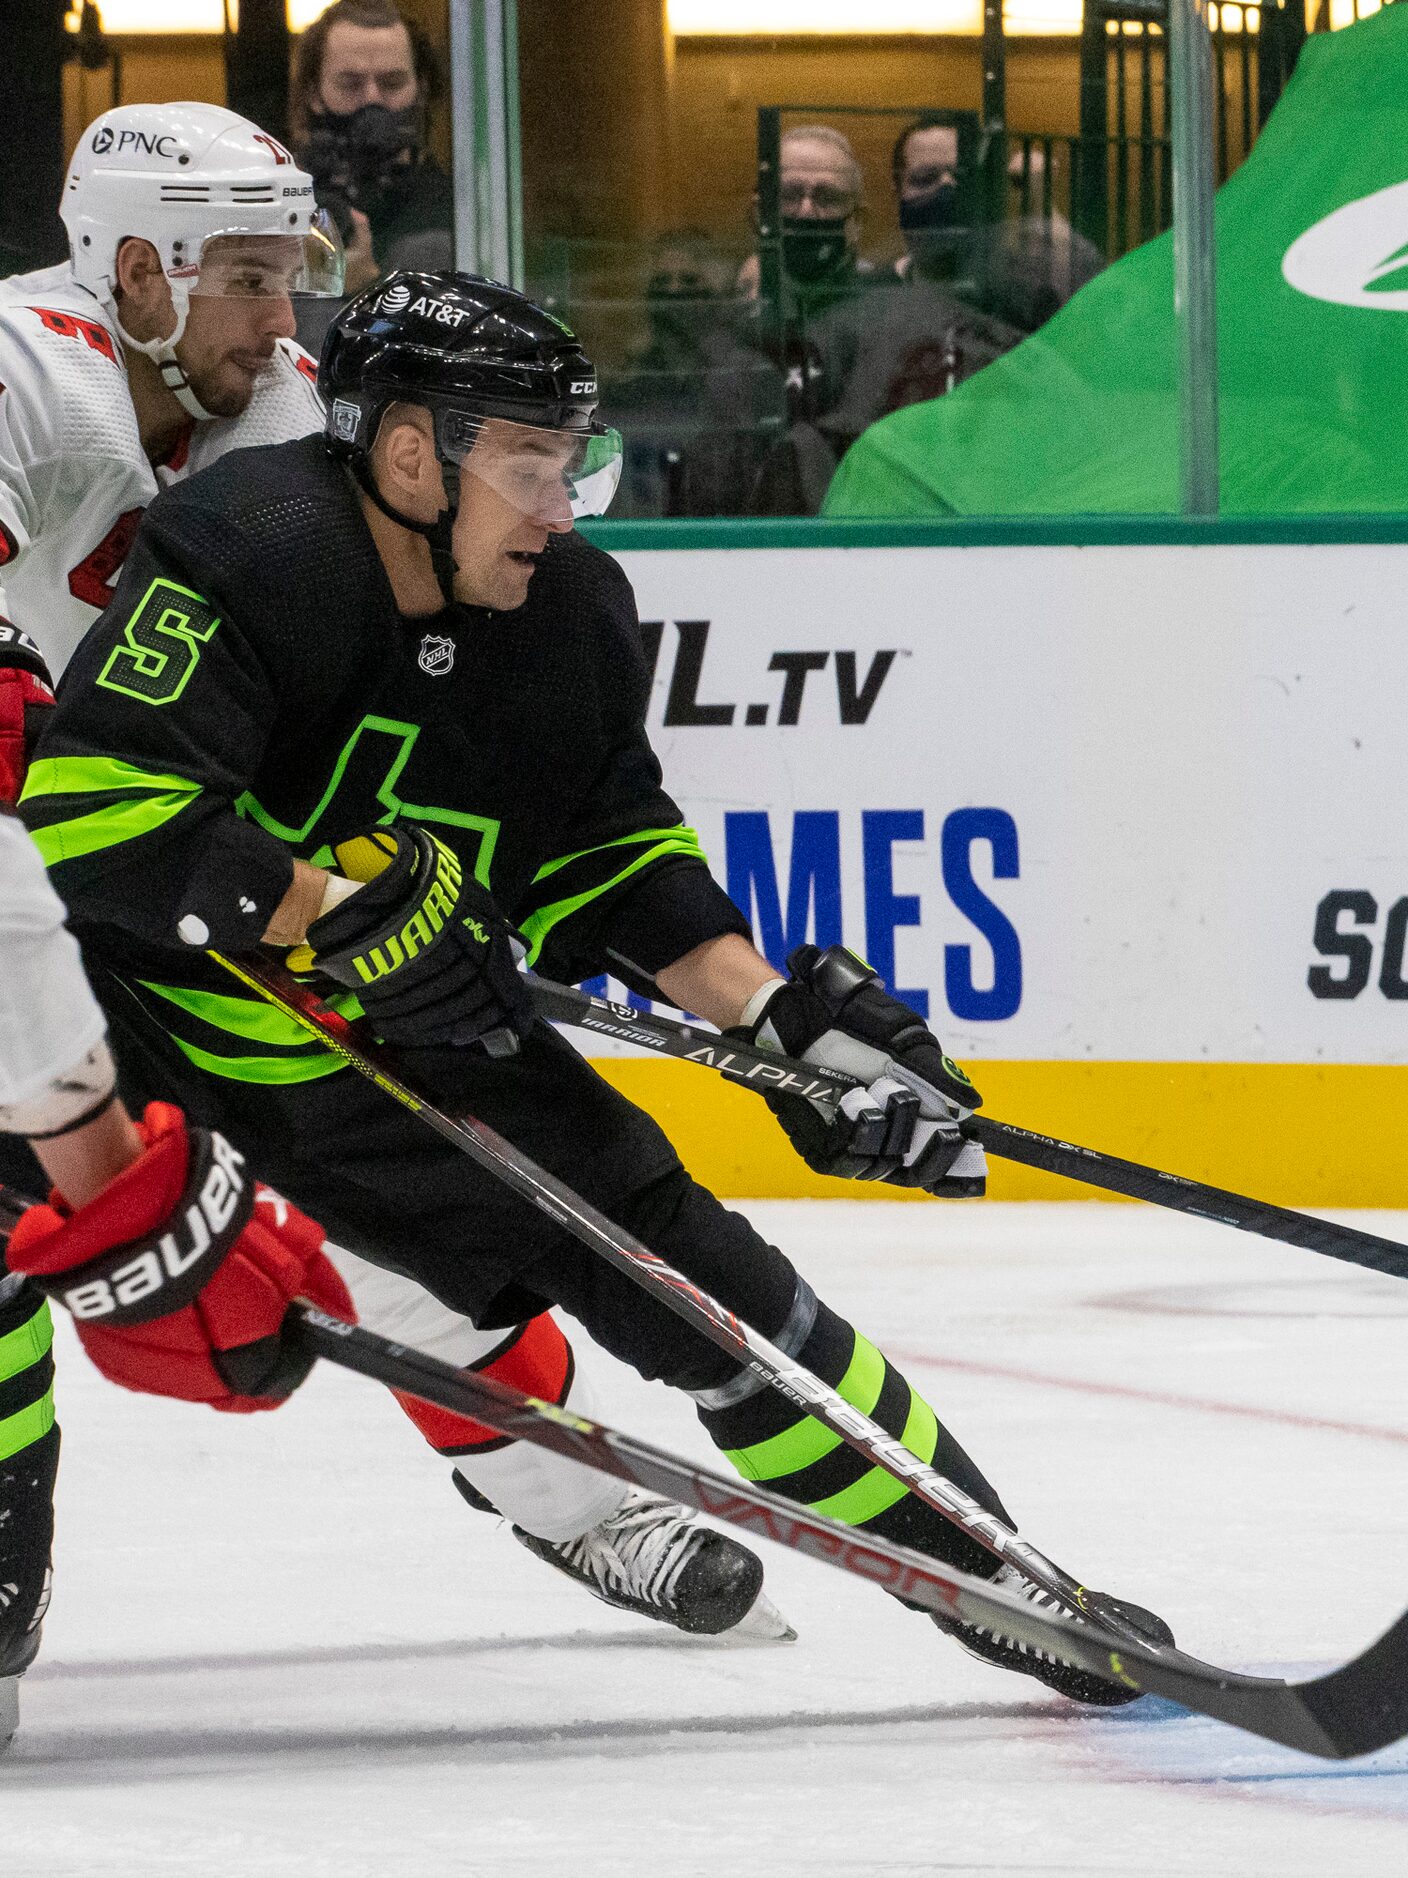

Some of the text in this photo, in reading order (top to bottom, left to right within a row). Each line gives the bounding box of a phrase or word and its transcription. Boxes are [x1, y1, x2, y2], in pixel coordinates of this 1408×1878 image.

[117, 131, 177, 158] PNC
[408, 296, 470, 328] AT&T
[96, 578, 222, 706] 5
[426, 648, 448, 666] NHL
[683, 1046, 842, 1104] ALPHA
[1001, 1125, 1054, 1145] ALPHA
[692, 1468, 962, 1614] VAPOR
